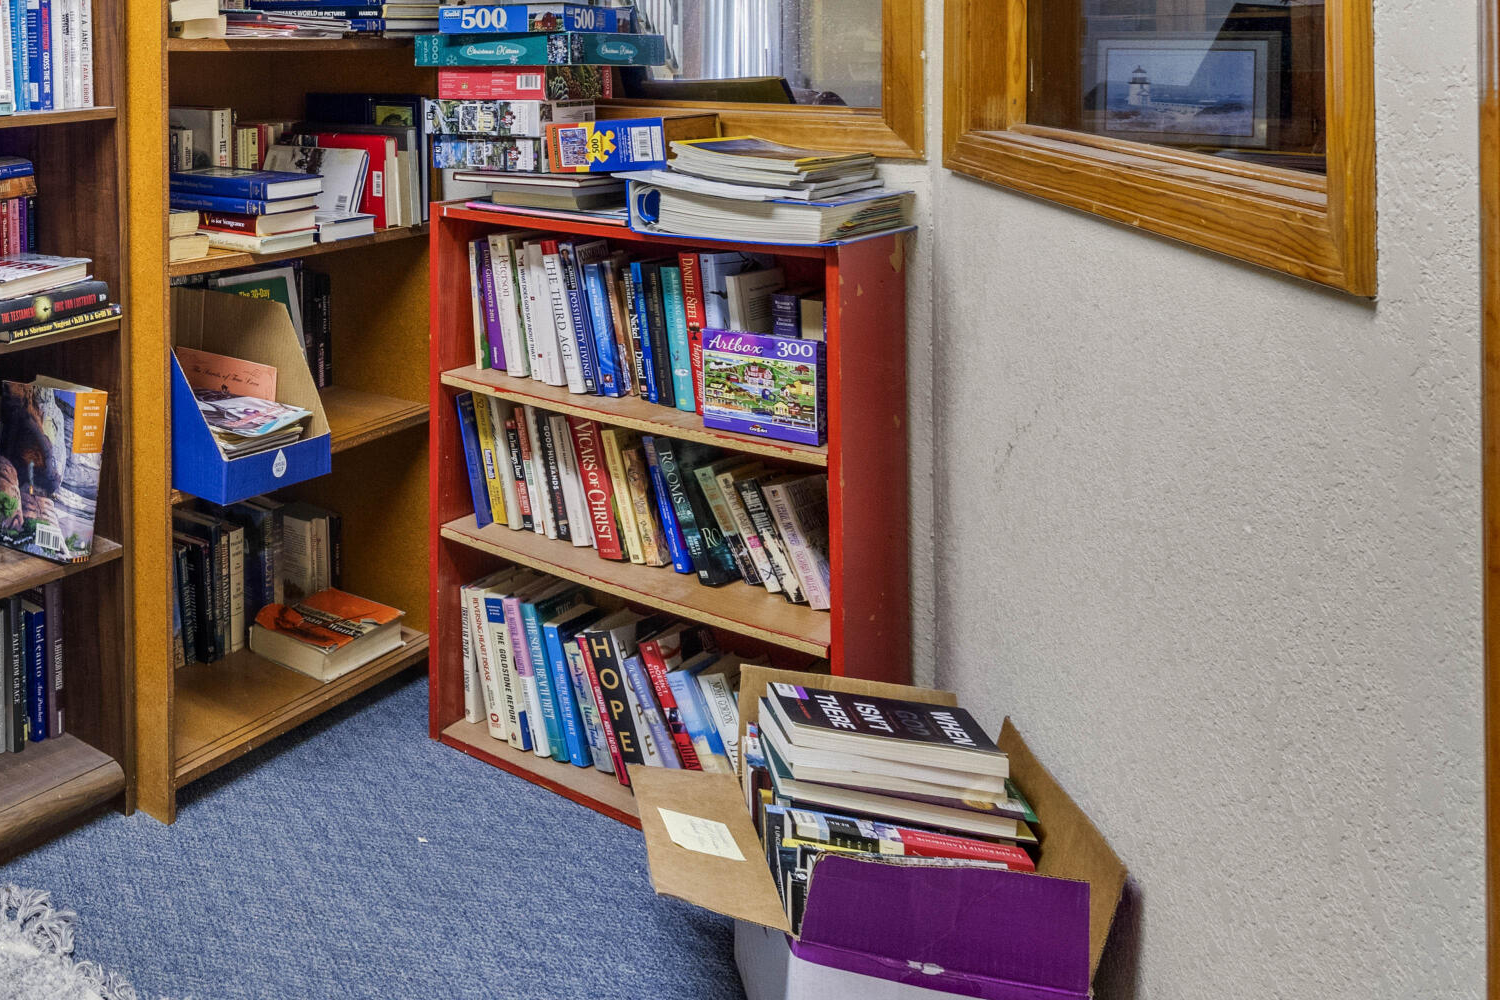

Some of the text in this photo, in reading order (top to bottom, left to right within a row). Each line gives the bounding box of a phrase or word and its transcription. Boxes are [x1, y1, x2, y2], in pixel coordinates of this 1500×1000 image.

[461, 8, 507, 29] 500
[574, 9, 594, 29] 500
[592, 138, 600, 154] 500
[545, 260, 573, 361] THE THIRD AGE
[686, 297, 698, 319] STEEL
[578, 344, 592, 377] LIVING
[708, 333, 814, 358] Artbox 300
[574, 421, 612, 542] VICARS OF CHRIST
[659, 450, 687, 507] ROOMS
[499, 648, 512, 692] GOLDSTONE
[590, 637, 636, 754] HOPE
[814, 694, 857, 731] THERE
[853, 702, 894, 733] ISN'T
[929, 711, 977, 747] WHEN
